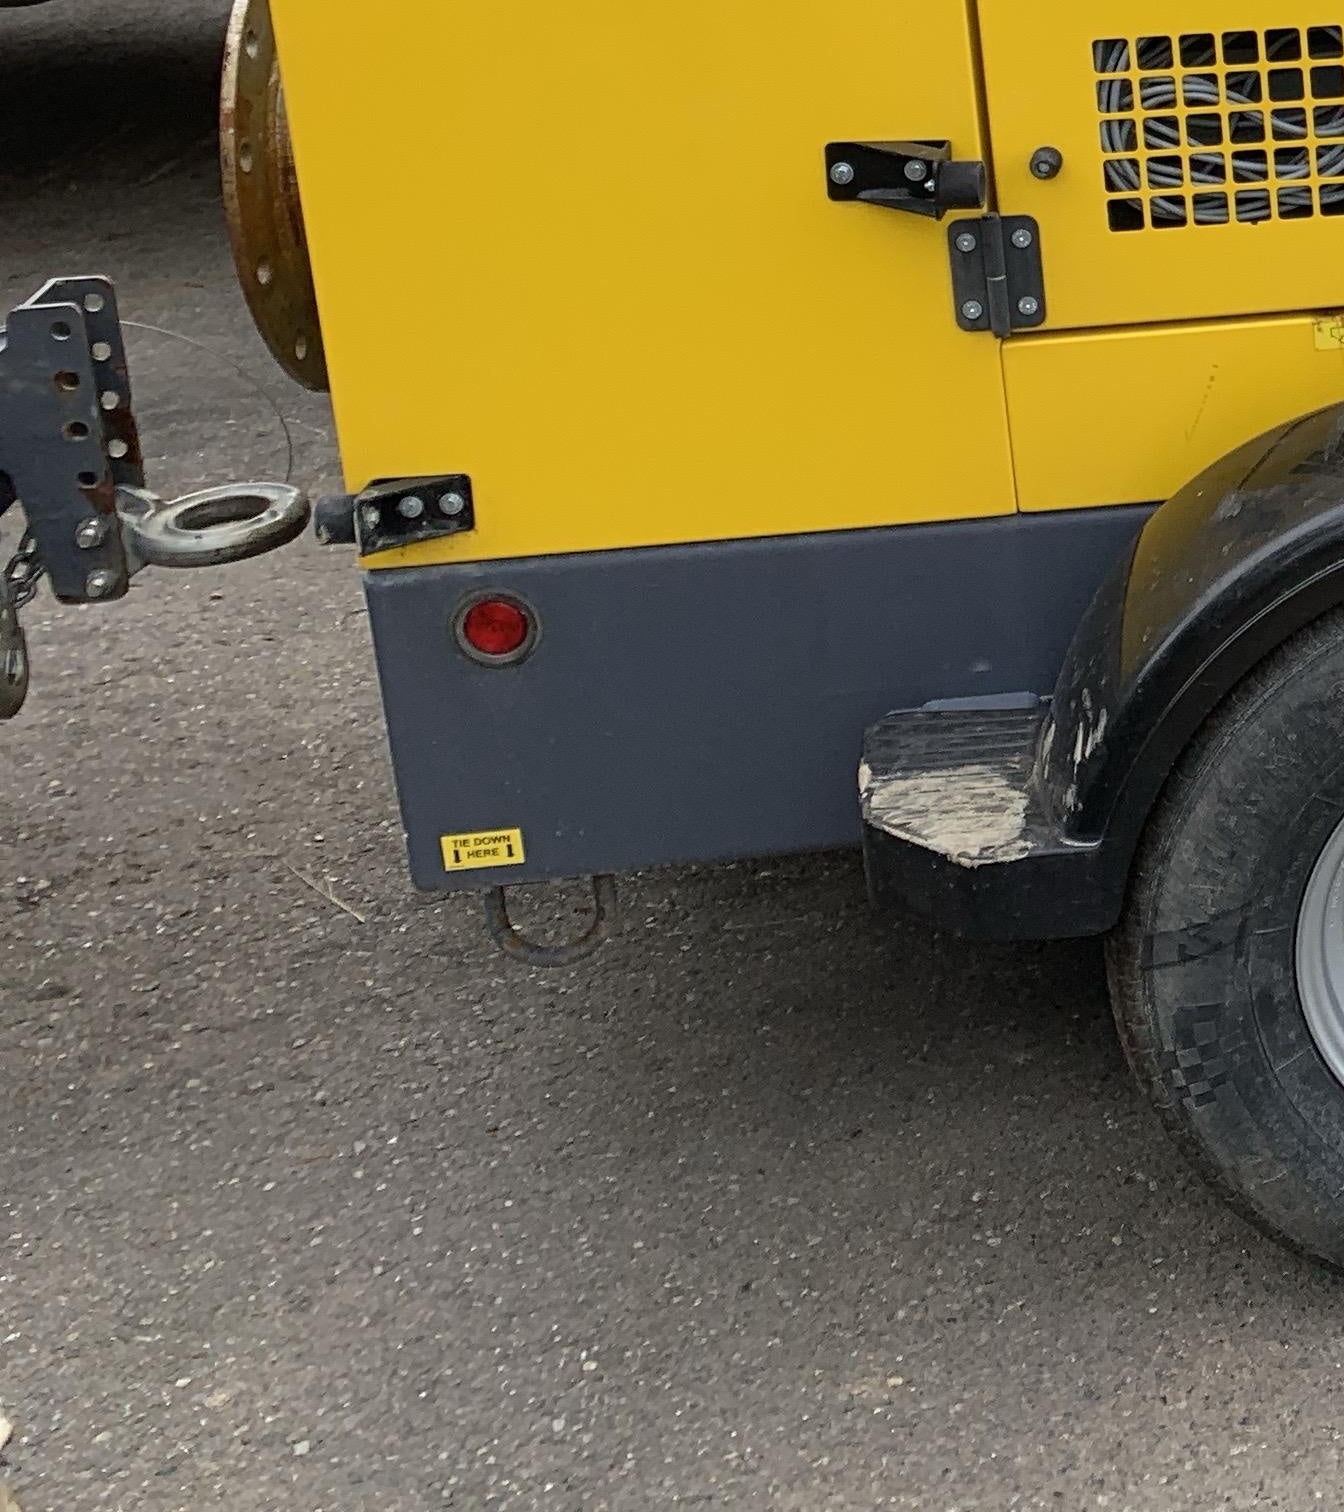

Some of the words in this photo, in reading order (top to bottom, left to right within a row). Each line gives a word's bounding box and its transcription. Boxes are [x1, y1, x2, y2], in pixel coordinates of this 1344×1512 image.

[452, 839, 470, 848] TIE
[474, 835, 510, 845] DOWN
[467, 848, 499, 859] HERE
